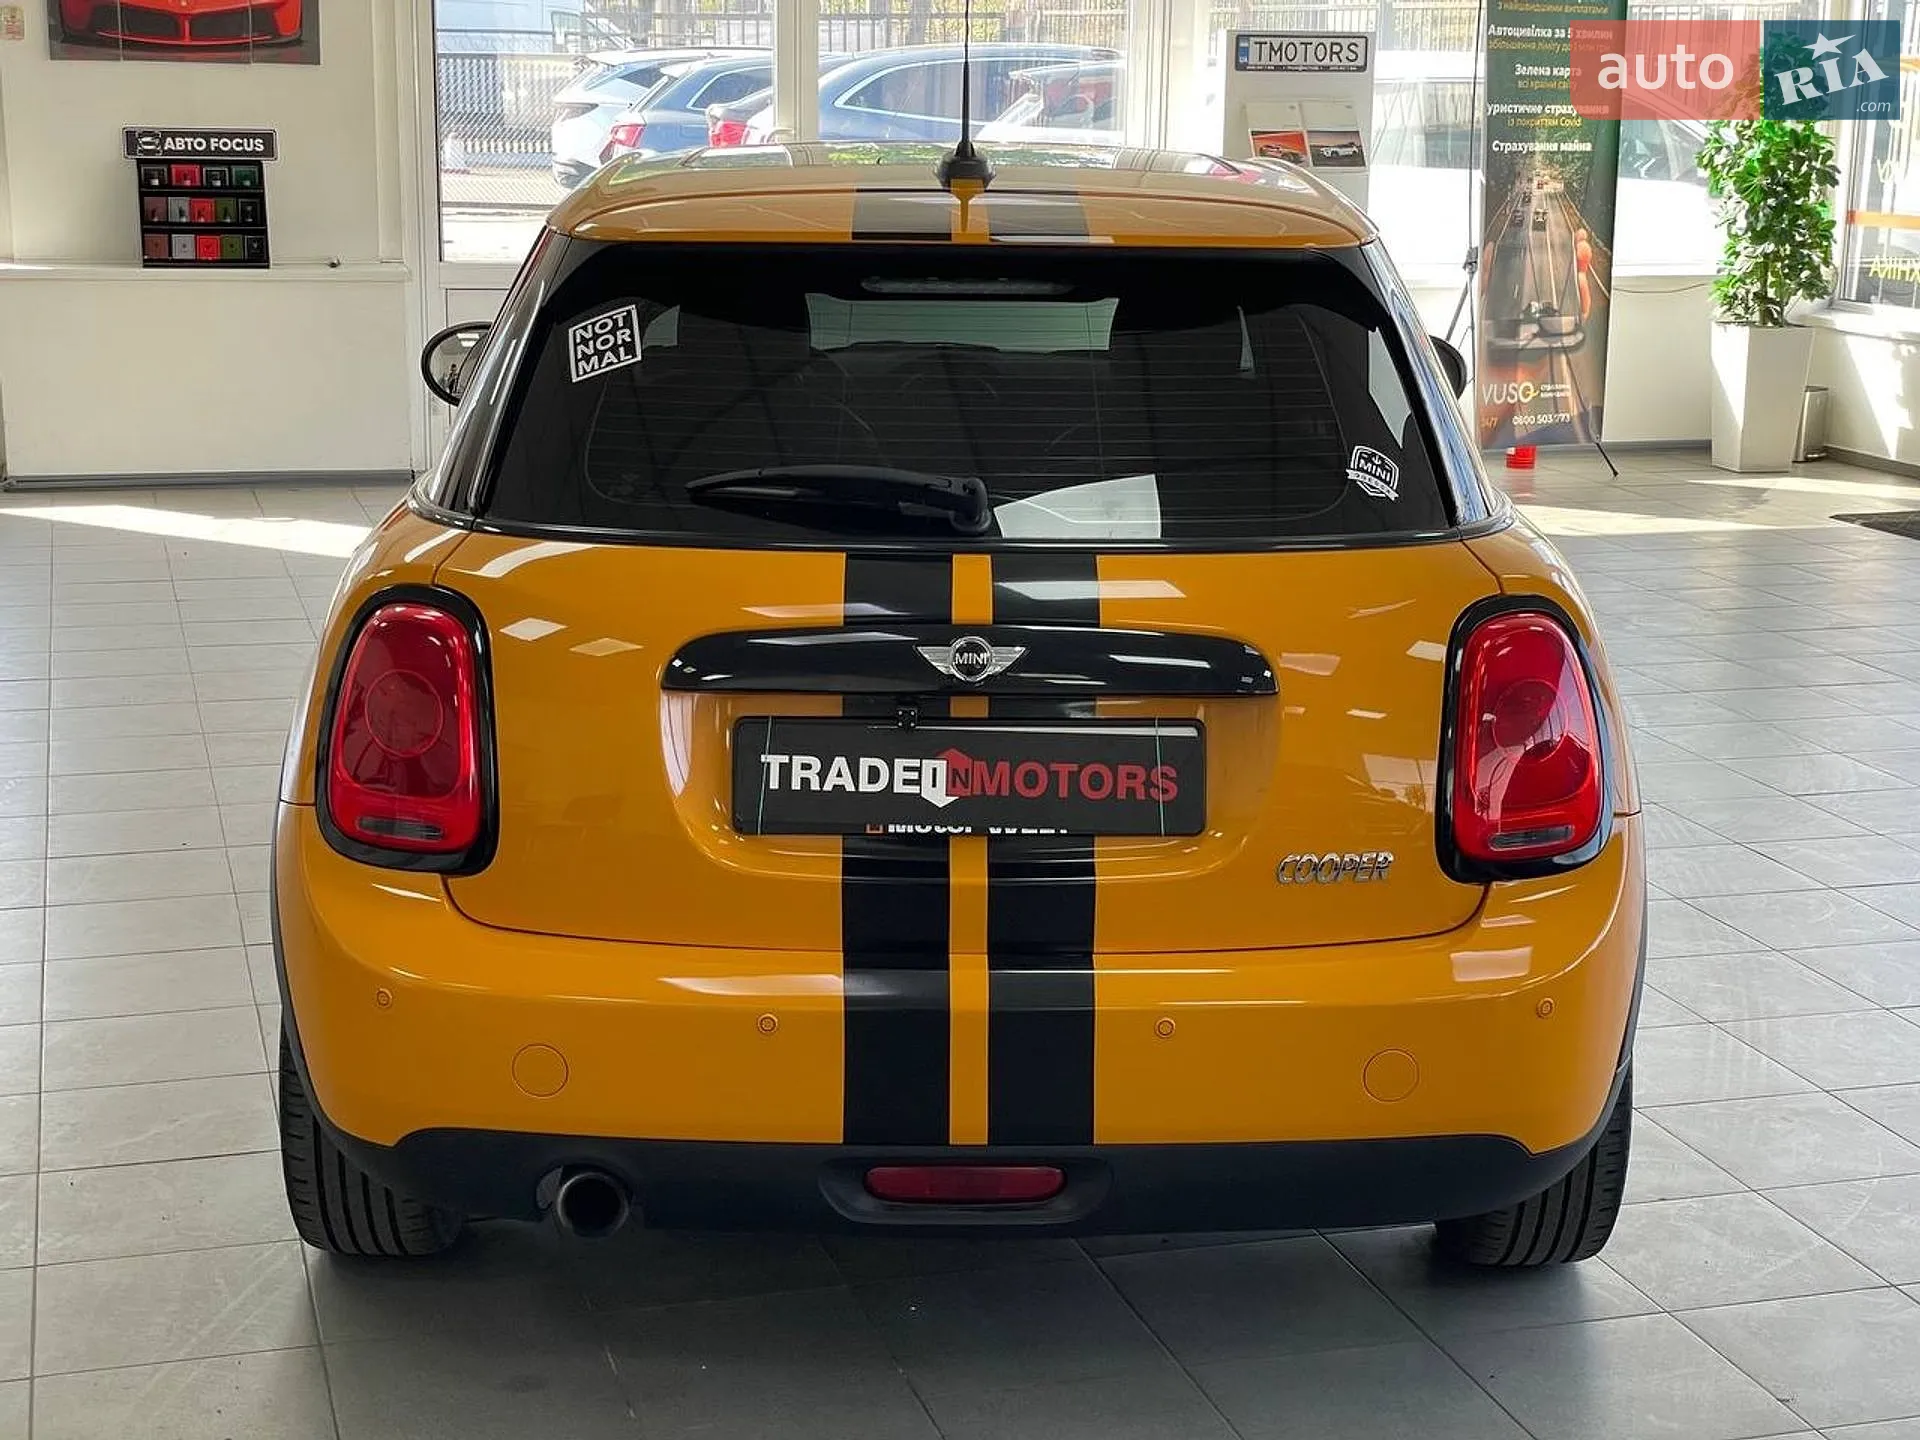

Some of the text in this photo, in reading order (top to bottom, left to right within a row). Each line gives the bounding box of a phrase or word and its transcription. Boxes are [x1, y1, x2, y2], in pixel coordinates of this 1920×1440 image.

[1254, 41, 1359, 63] TMOTORS
[1514, 64, 1551, 76] Зелена
[1487, 103, 1543, 116] уристичне
[210, 138, 265, 151] FOCUS
[1492, 140, 1593, 154] Страхування майна
[575, 311, 628, 344] NOT
[576, 328, 632, 360] NOR
[577, 346, 633, 375] MAL
[1359, 458, 1391, 482] MINI
[955, 652, 988, 665] MINI
[760, 754, 921, 794] TRADE
[974, 759, 1179, 802] MOTORS
[1277, 851, 1395, 884] COOPER
